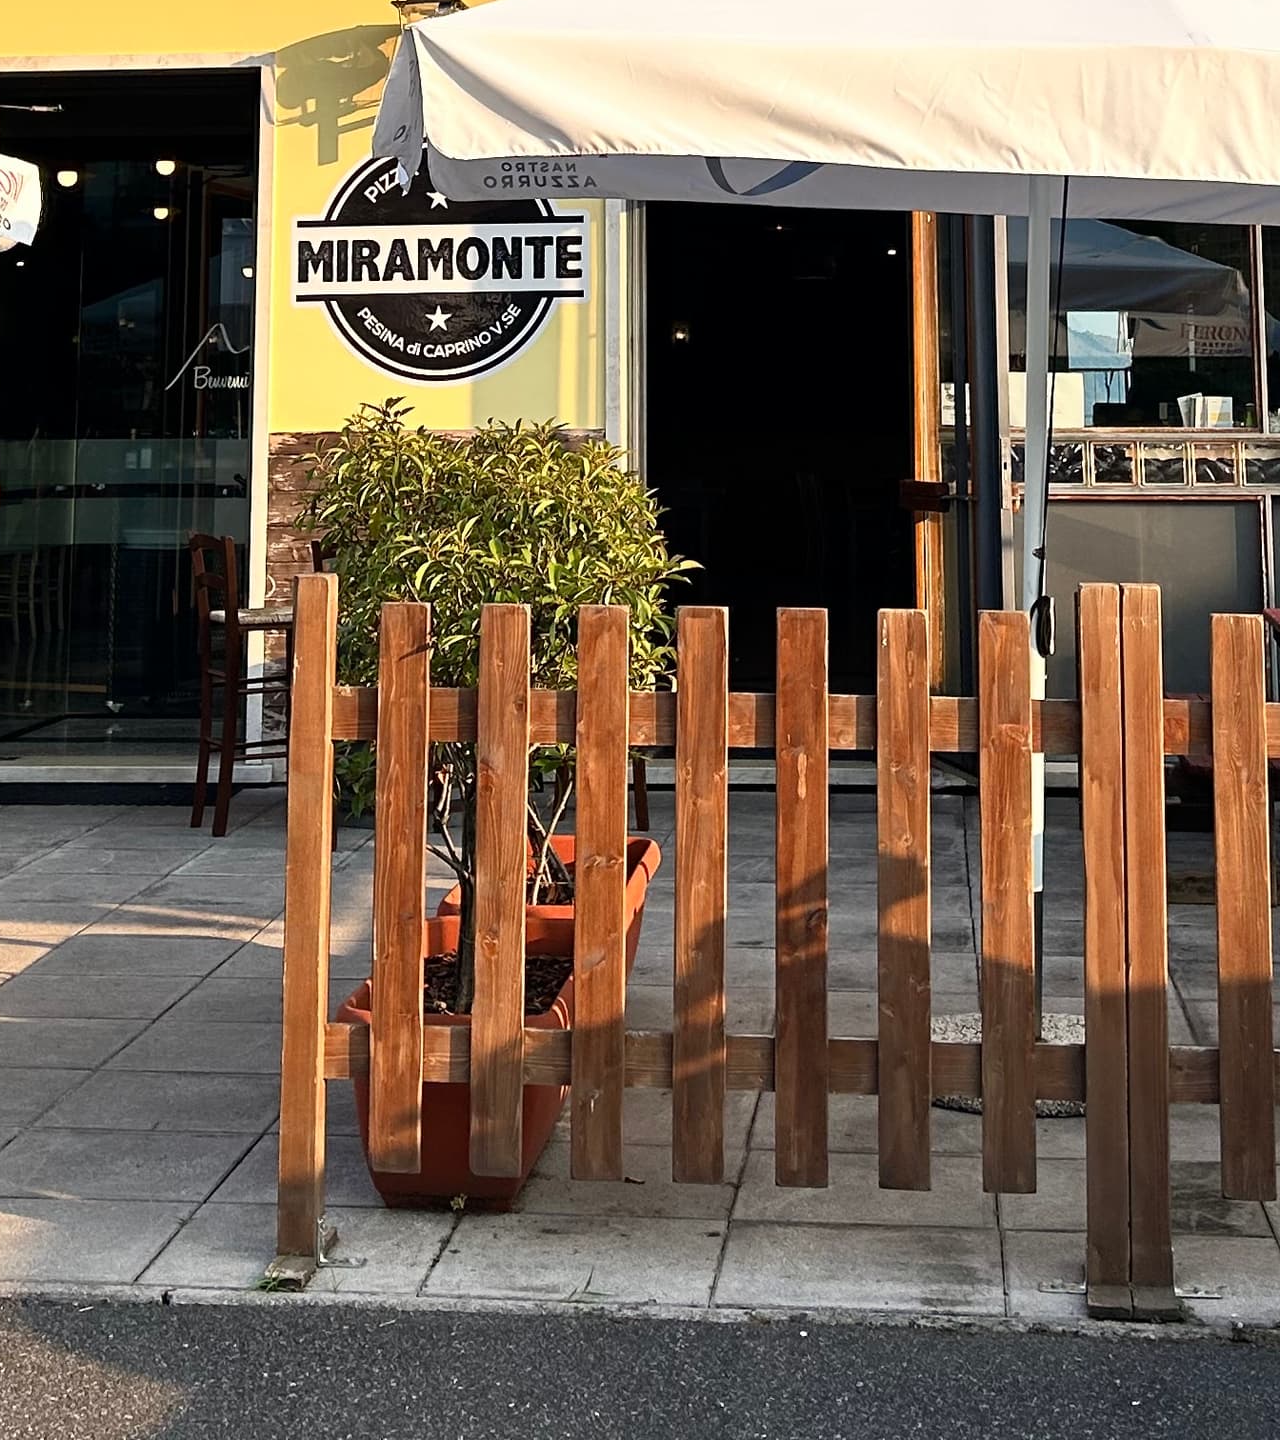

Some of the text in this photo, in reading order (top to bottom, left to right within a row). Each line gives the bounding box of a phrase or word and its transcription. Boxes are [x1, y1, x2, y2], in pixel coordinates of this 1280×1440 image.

[363, 166, 401, 204] PIZZ
[298, 236, 583, 283] MIRAMONTE
[357, 306, 405, 352] PESINA
[406, 342, 421, 356] di
[423, 331, 492, 358] CAPRINO
